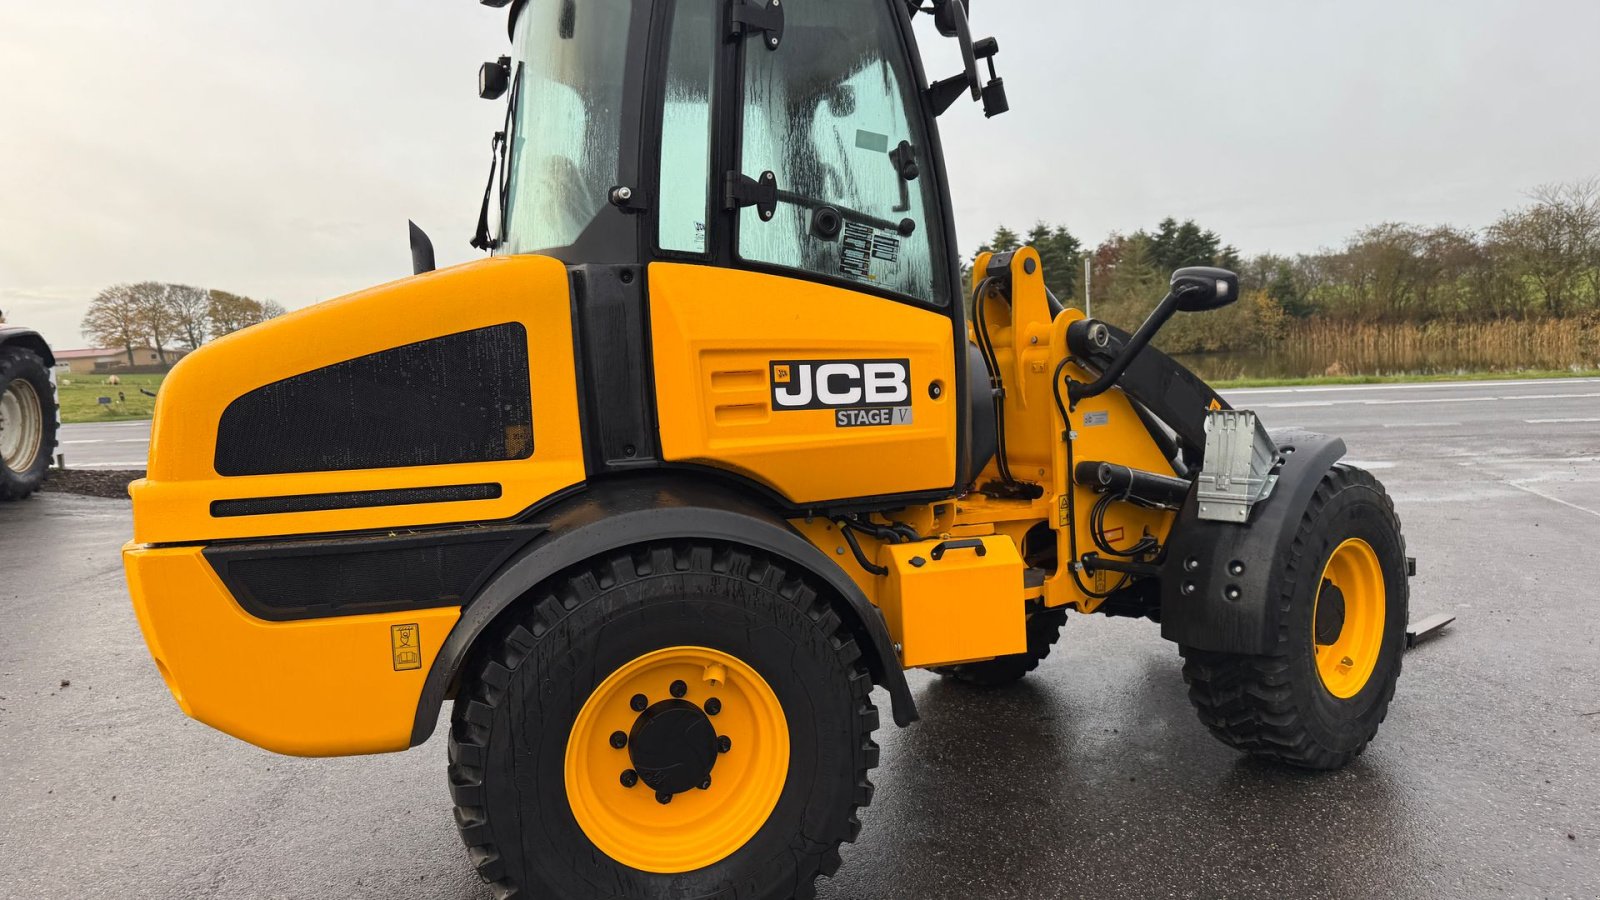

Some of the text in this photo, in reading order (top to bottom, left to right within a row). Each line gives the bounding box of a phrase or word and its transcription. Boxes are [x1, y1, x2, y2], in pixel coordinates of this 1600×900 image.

[775, 363, 908, 406] JCB
[838, 408, 908, 426] STAGE V
